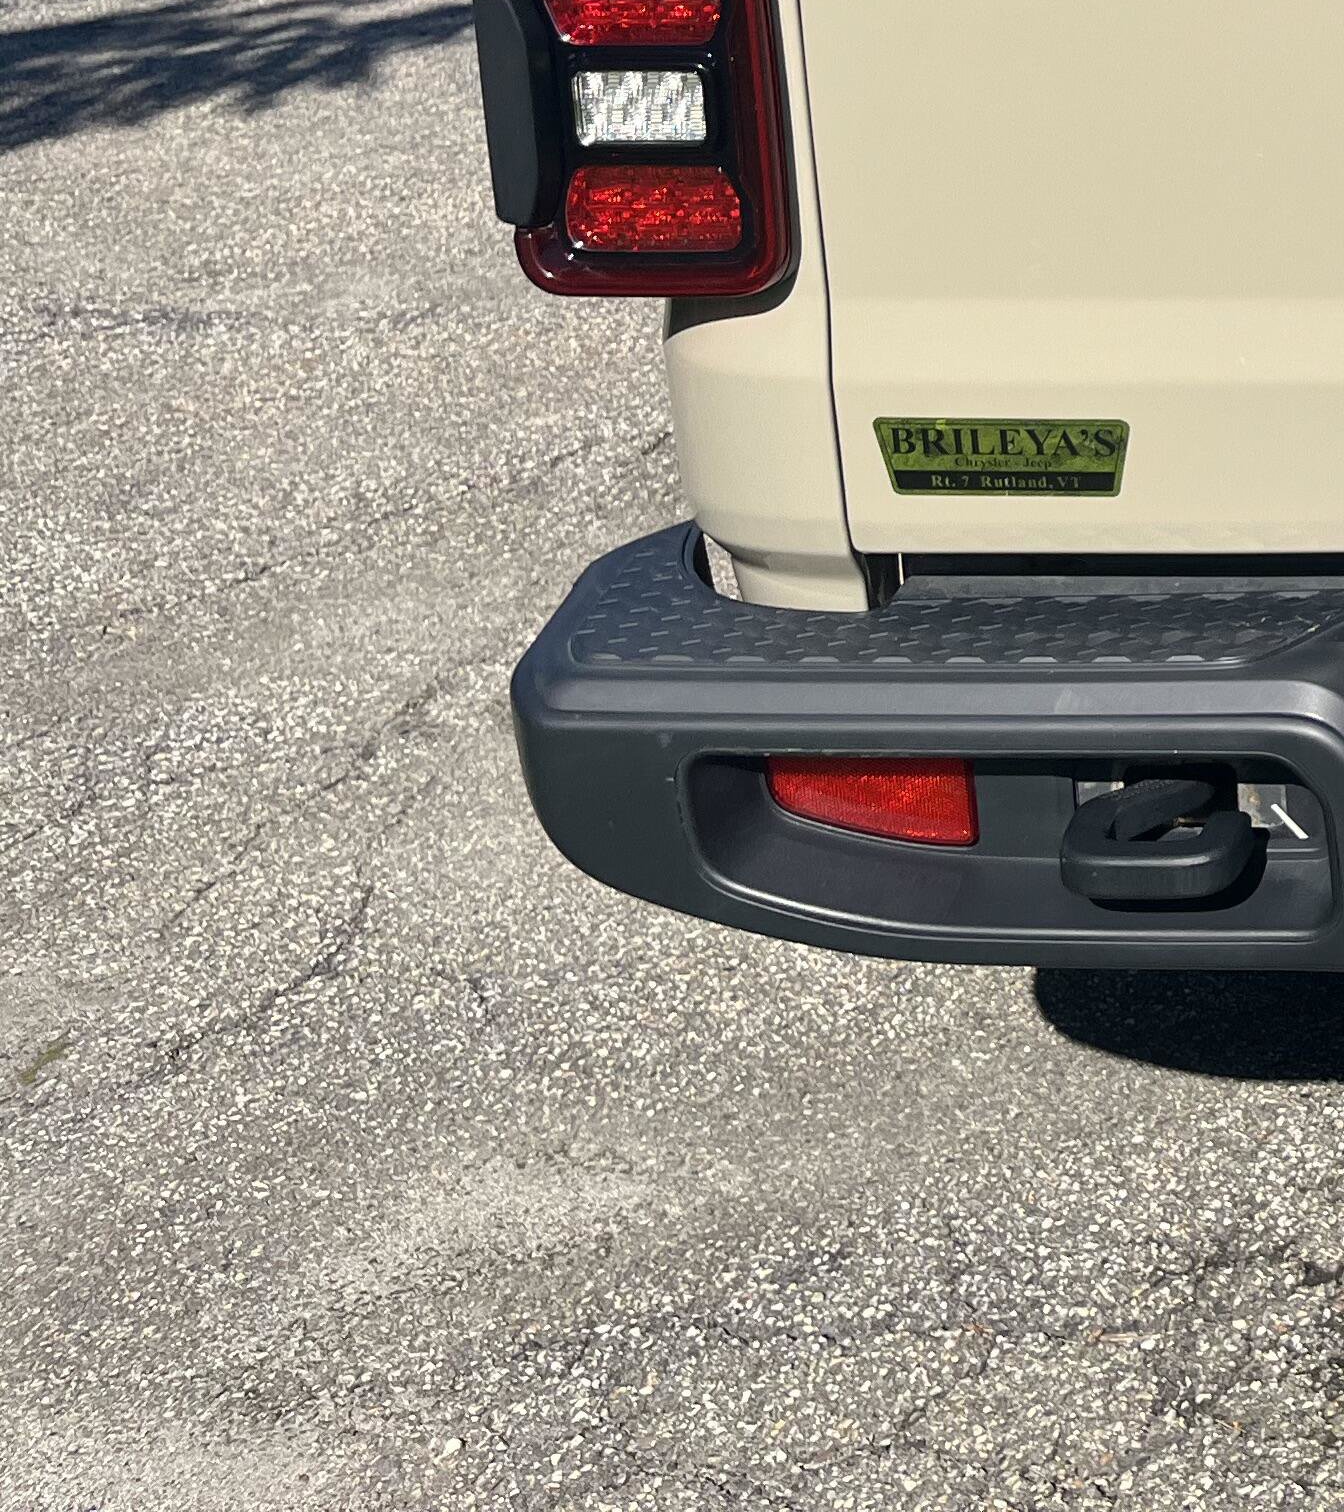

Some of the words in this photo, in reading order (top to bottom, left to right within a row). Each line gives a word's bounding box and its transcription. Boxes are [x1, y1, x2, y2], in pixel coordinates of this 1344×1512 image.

[890, 427, 1117, 458] BRILEYA'S
[954, 456, 1011, 471] Chrysler
[1023, 457, 1053, 471] Jeep
[930, 475, 956, 488] Rt.
